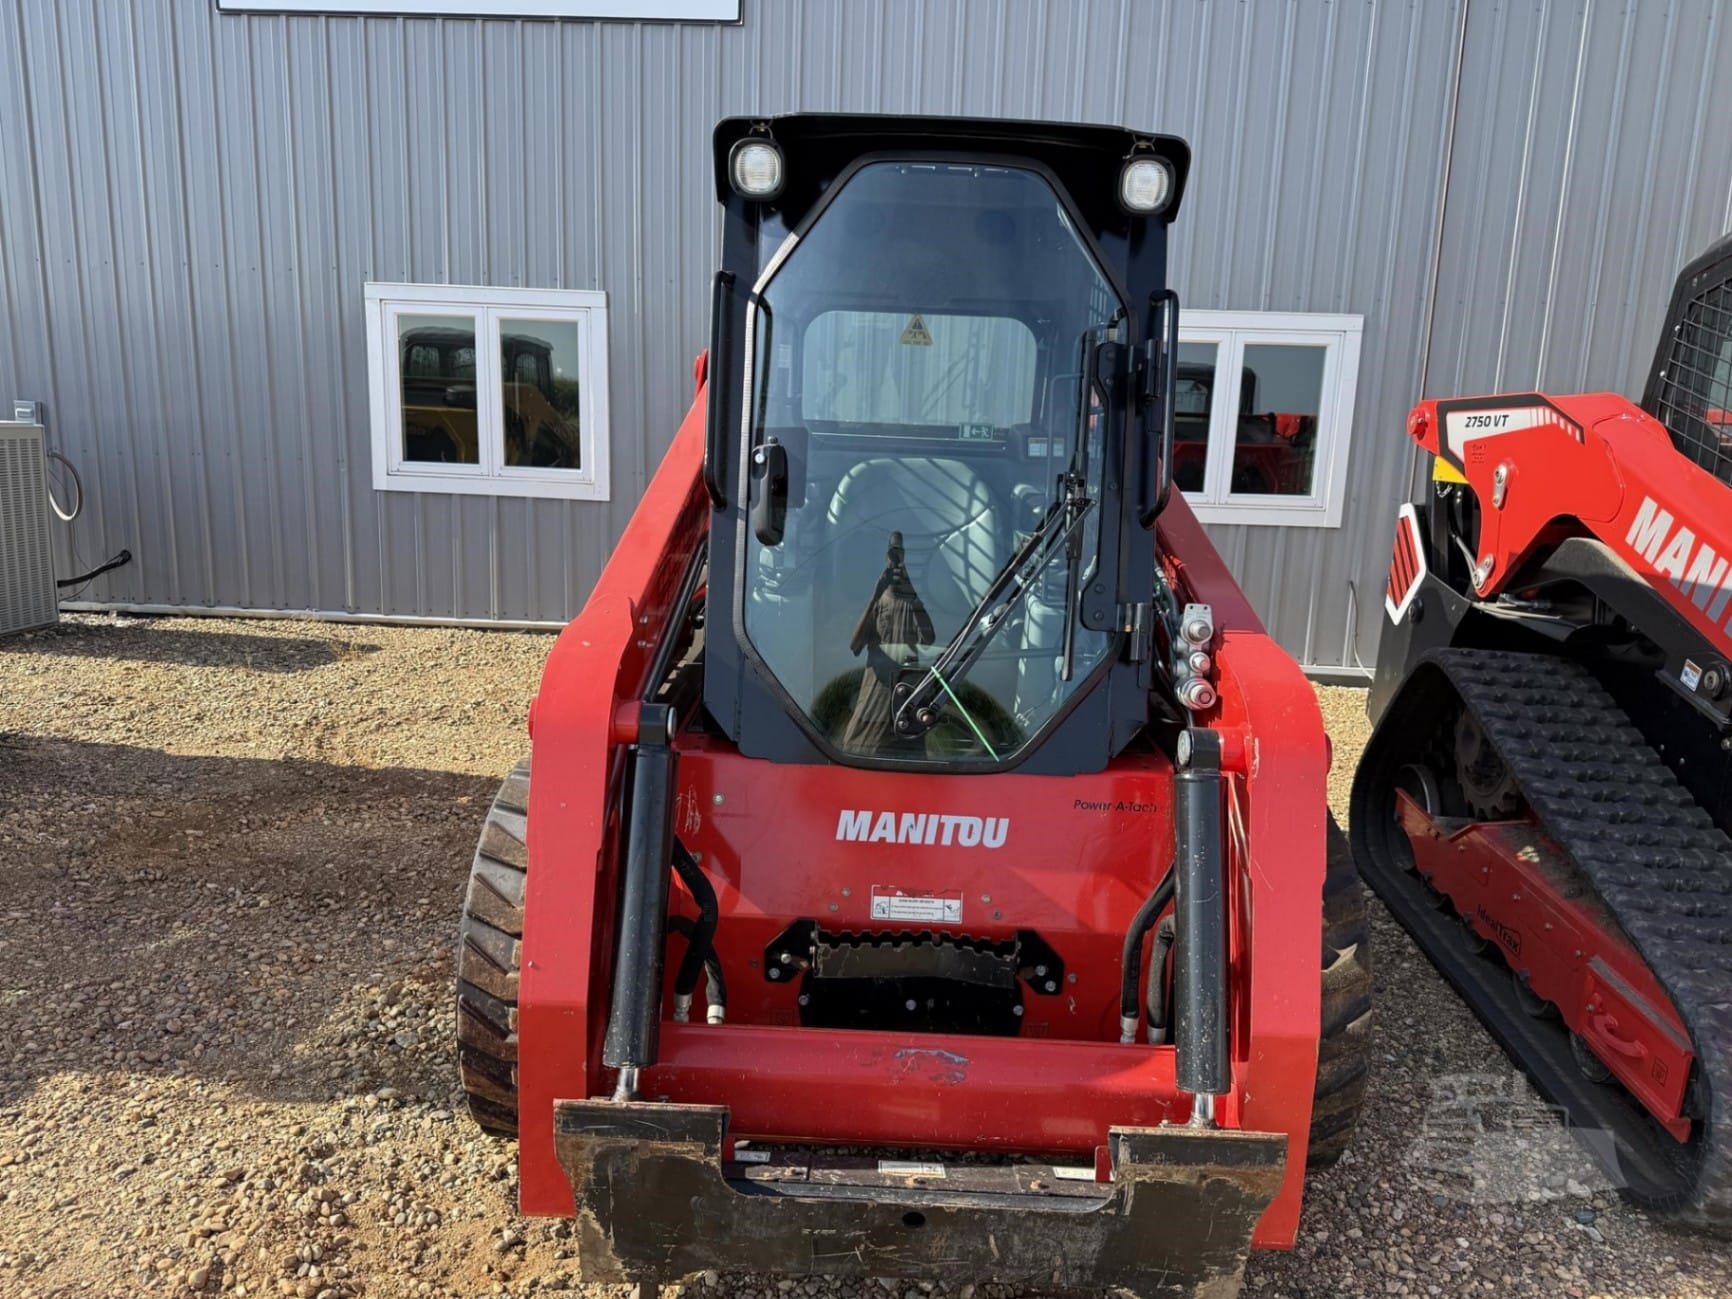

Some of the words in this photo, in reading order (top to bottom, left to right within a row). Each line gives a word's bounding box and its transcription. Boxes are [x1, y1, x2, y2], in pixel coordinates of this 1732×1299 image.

[1465, 416, 1492, 428] 2750
[1494, 415, 1509, 428] VT
[1625, 496, 1732, 638] MANI
[836, 809, 1010, 849] MANITOU
